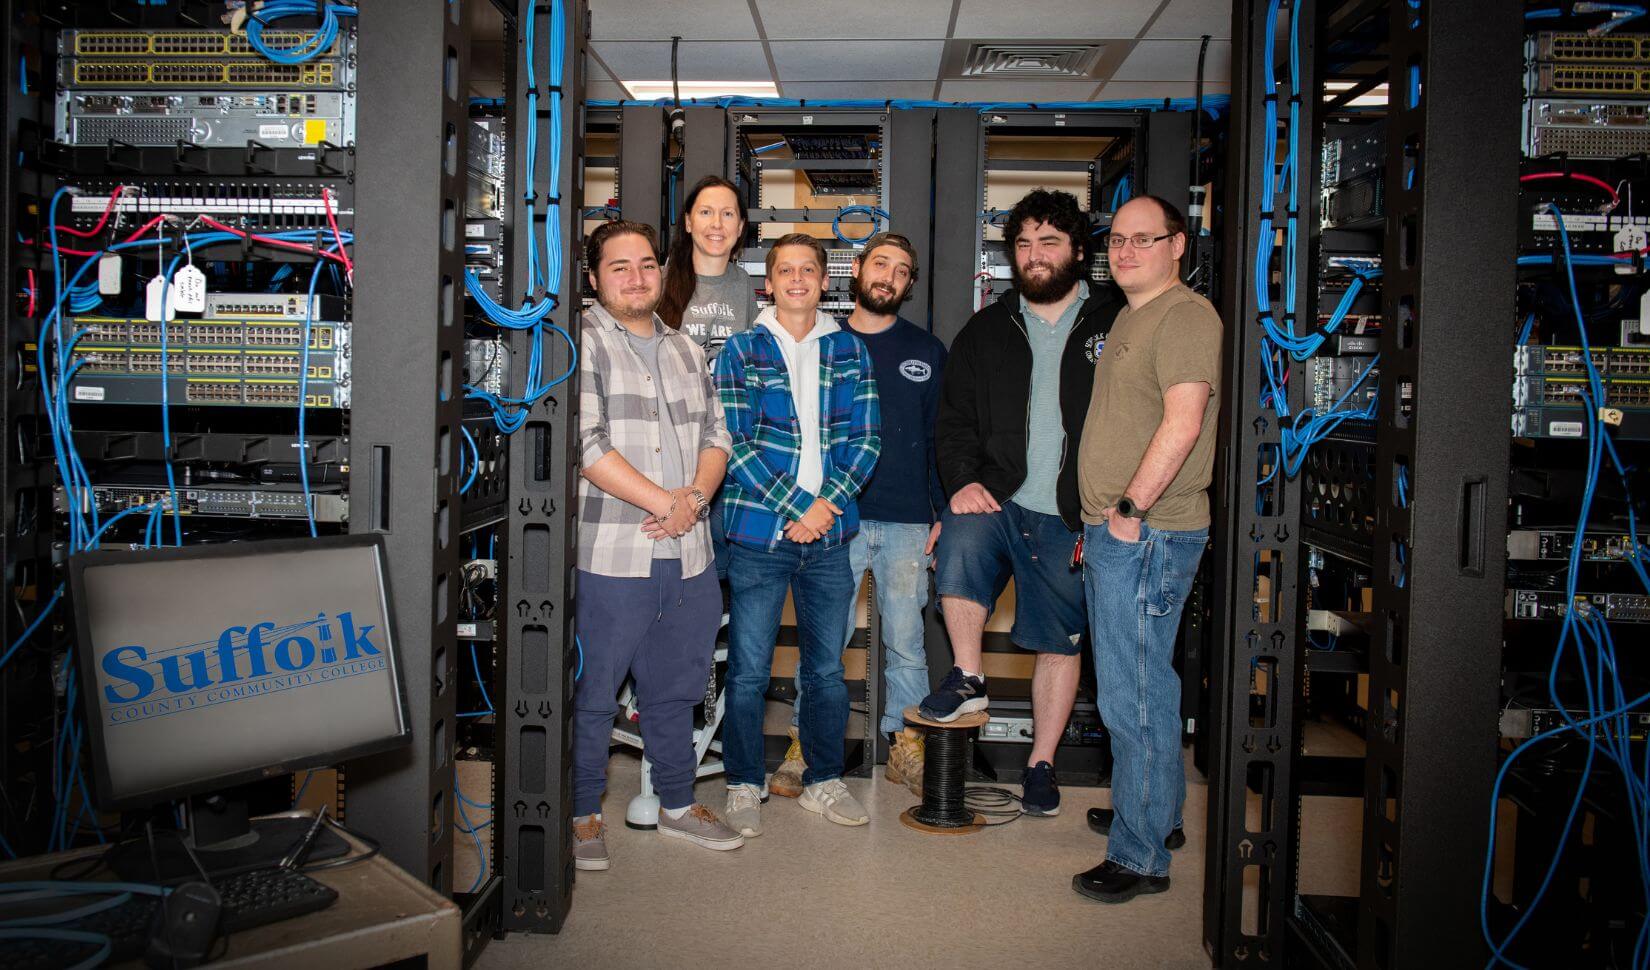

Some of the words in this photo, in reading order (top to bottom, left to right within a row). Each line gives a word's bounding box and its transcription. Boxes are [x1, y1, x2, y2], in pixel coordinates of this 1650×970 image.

[690, 303, 734, 316] Suffolk
[686, 324, 706, 335] WE
[710, 325, 732, 337] ARE
[101, 612, 381, 704] Suffolk
[110, 695, 198, 722] COUNTY
[207, 672, 314, 701] COMMUNITY
[320, 658, 386, 679] COLLEGE
